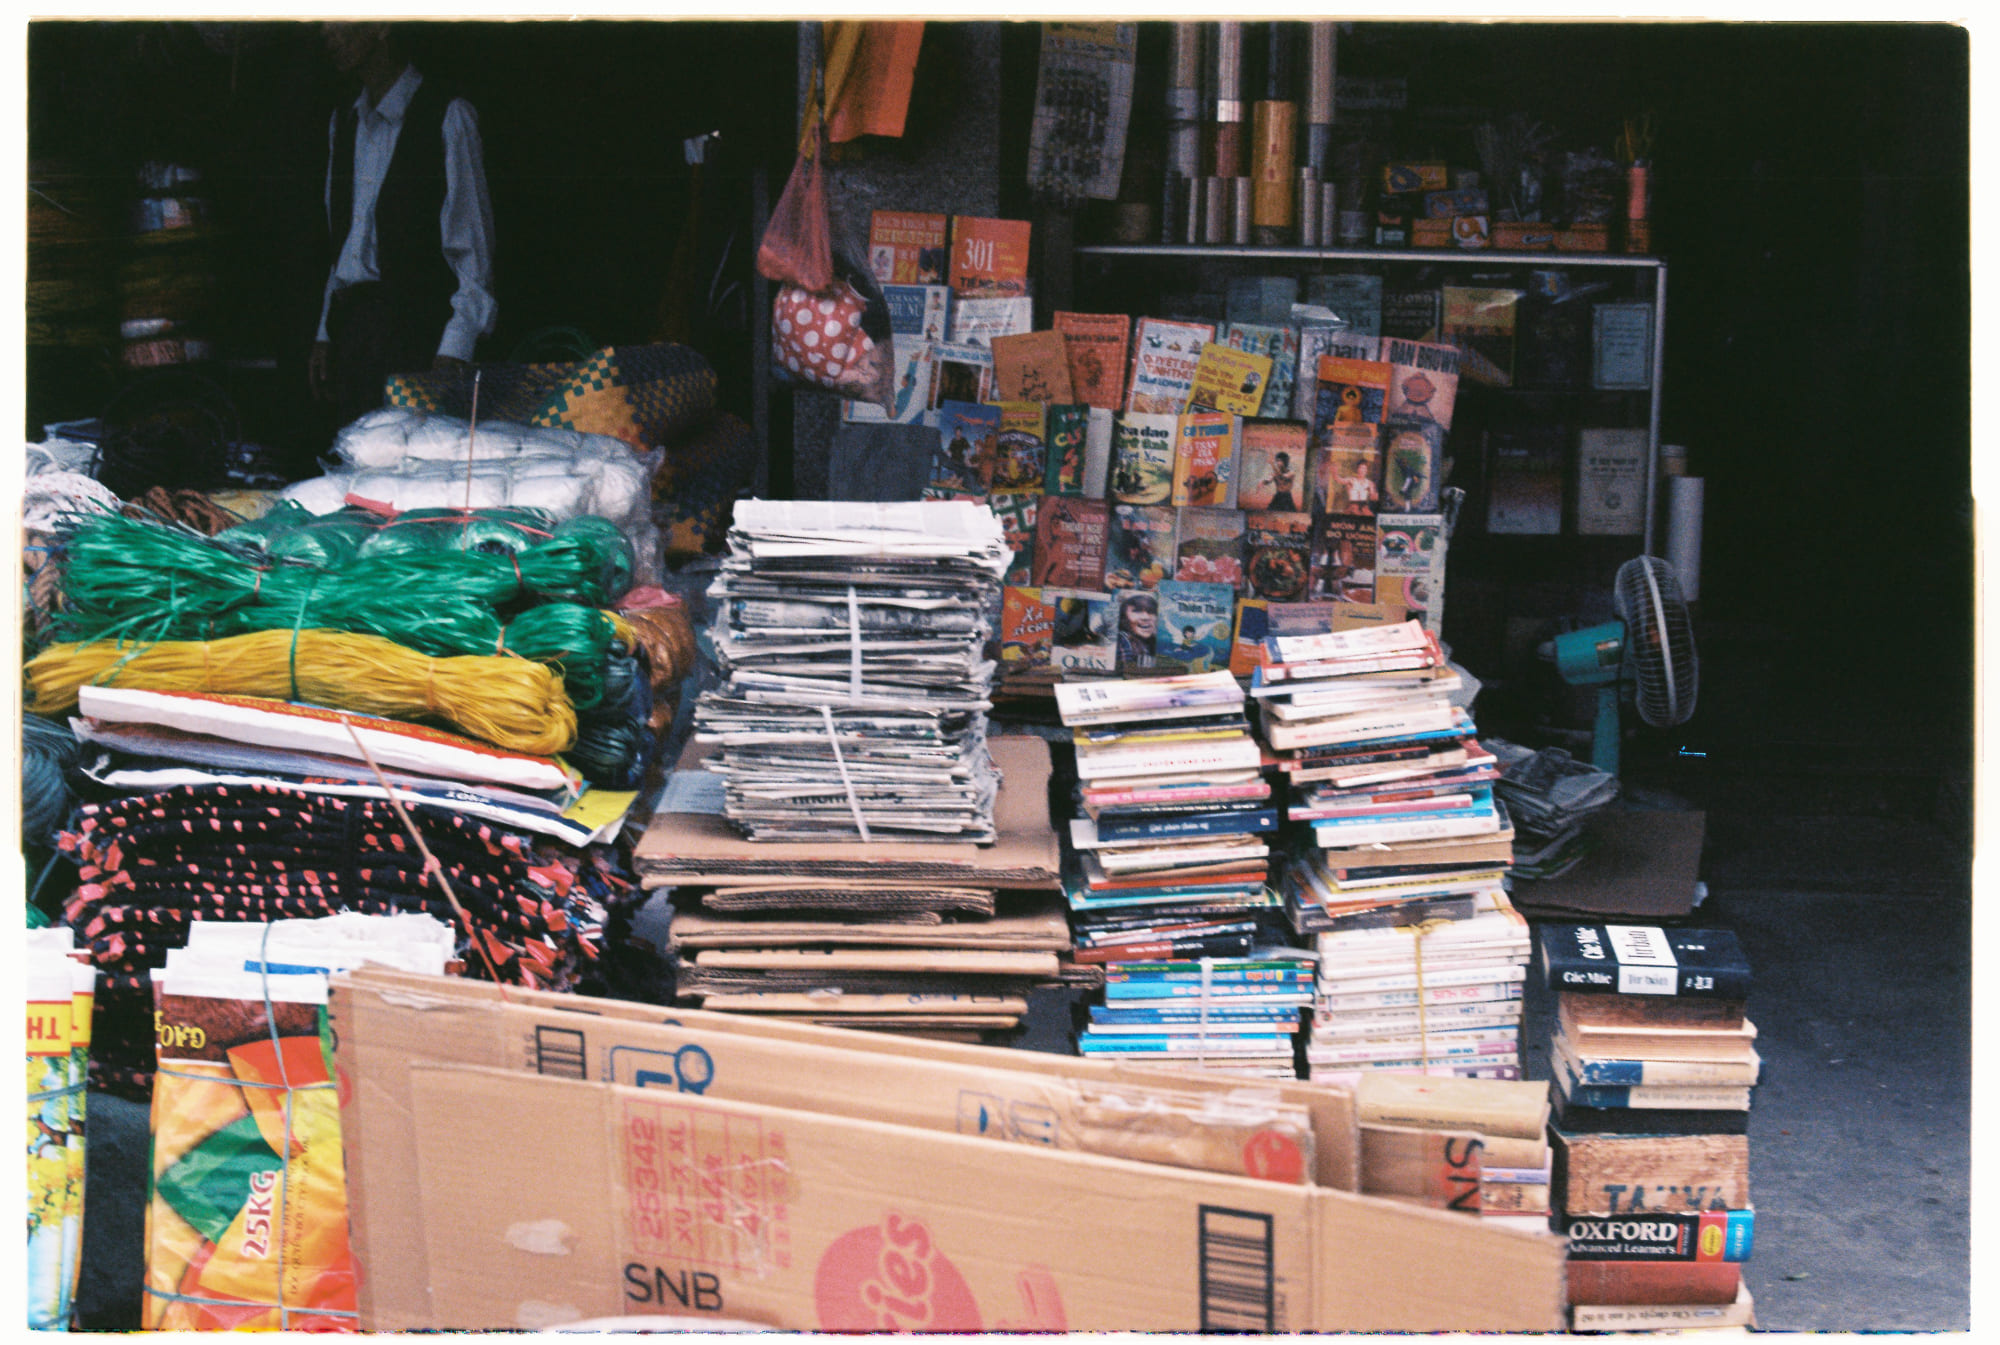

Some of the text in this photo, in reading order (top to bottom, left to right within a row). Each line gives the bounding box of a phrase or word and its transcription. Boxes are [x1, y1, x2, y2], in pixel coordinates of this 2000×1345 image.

[961, 238, 995, 272] 301
[1390, 340, 1416, 366] DAN
[1418, 344, 1460, 373] BROWN
[1141, 425, 1169, 439] dao
[631, 1116, 665, 1240] 25342
[244, 1171, 275, 1257] 25KG
[1569, 1221, 1678, 1243] OXFORD
[625, 1262, 724, 1311] SNB
